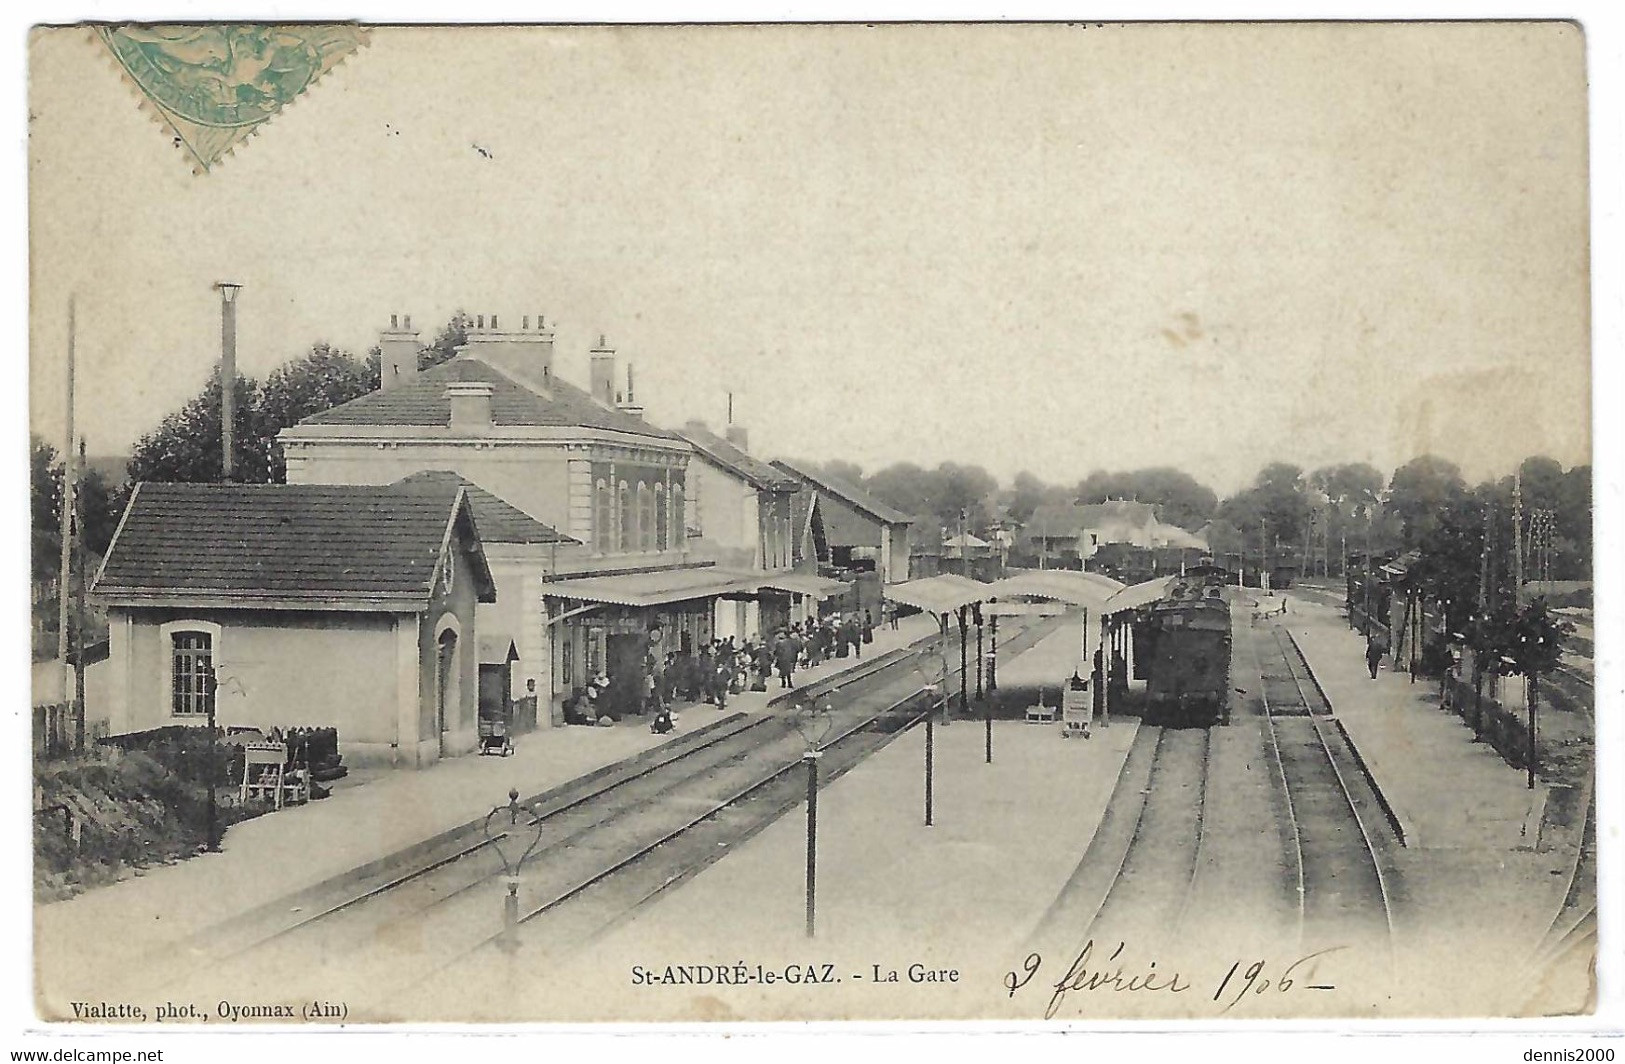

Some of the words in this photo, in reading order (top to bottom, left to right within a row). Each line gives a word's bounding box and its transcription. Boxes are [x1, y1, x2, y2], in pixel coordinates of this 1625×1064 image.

[632, 960, 842, 985] St-ANDRÉ-le-GAZ.
[873, 964, 899, 983] La
[908, 963, 959, 983] Gare
[1045, 939, 1190, 1020] février
[70, 1001, 147, 1022] Vialatte,
[156, 1001, 208, 1023] phot.,
[217, 1000, 295, 1023] Oyonnax
[302, 1001, 348, 1020] (Ain)
